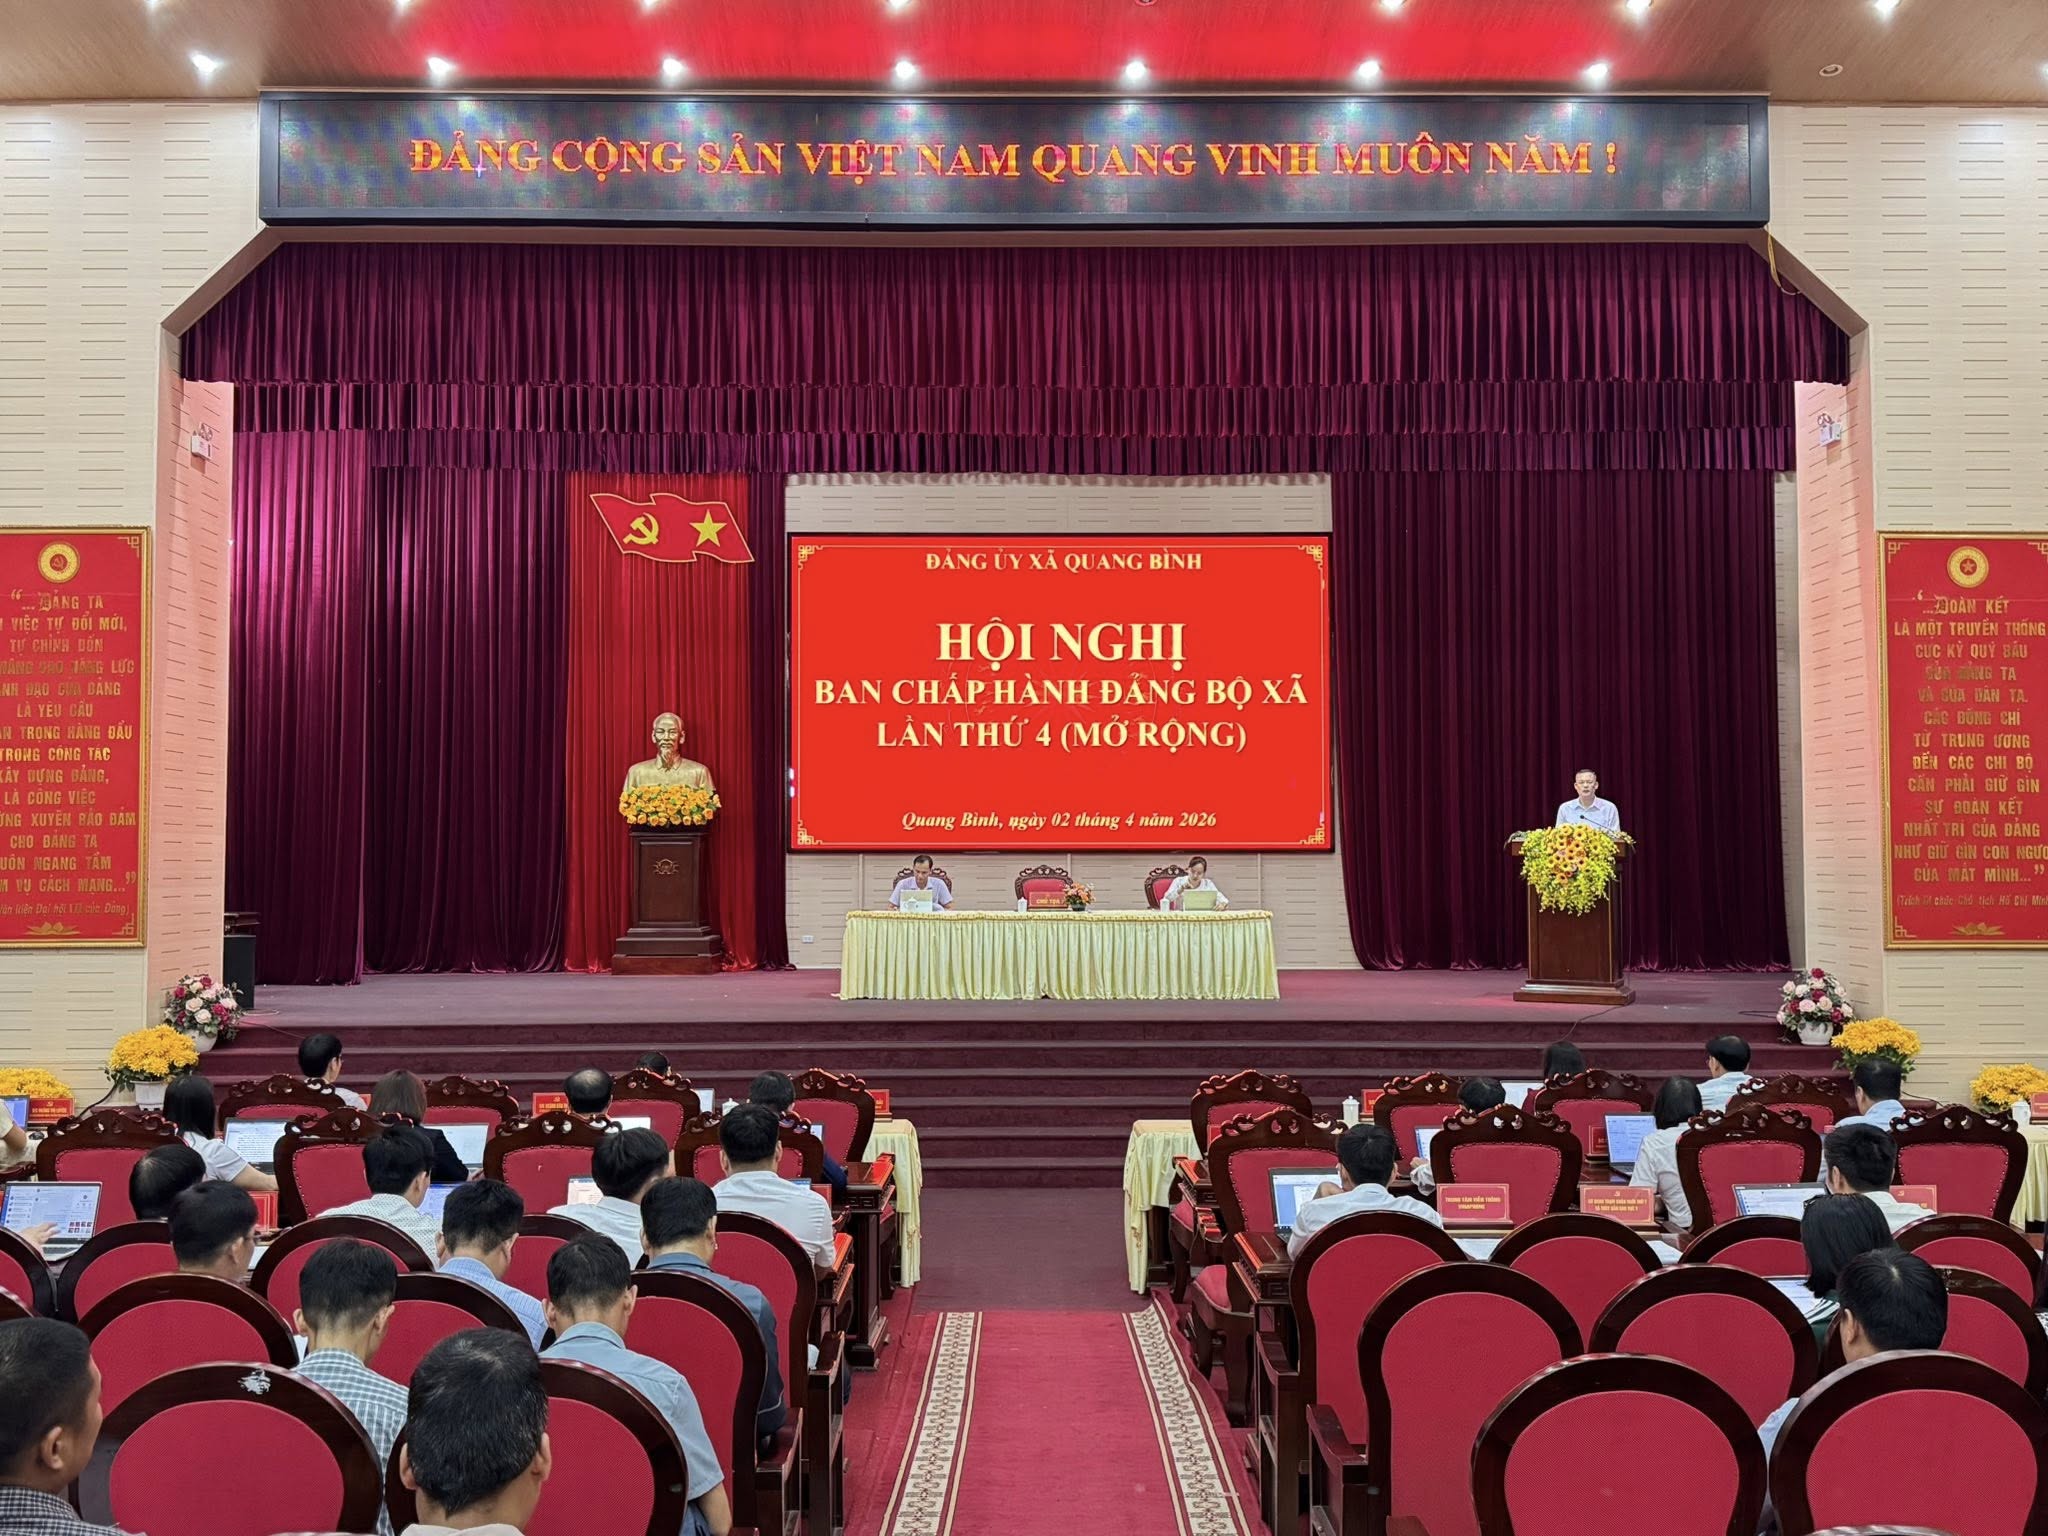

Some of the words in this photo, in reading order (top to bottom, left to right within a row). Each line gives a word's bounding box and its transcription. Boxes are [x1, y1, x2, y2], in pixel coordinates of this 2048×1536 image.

[408, 131, 539, 172] ĐẢNG
[552, 137, 686, 183] CỘNG
[697, 133, 782, 175] SẢN
[798, 139, 902, 185] VIỆT
[914, 144, 1021, 177] NAM
[1032, 144, 1197, 183] QUANG
[1206, 143, 1321, 176] VINH
[1333, 132, 1473, 175] MUÔN
[1486, 135, 1592, 175] NĂM
[926, 548, 987, 570] ĐẢNG
[994, 548, 1023, 570] ỦY
[1029, 549, 1059, 570] XÃ
[1064, 553, 1143, 573] QUANG
[1149, 547, 1203, 570] BÌNH
[936, 616, 1035, 671] HỘI
[1050, 622, 1186, 671] NGHỊ
[815, 679, 882, 705] BAN
[892, 673, 986, 704] CHẤP
[993, 673, 1090, 704] HÀNH
[1099, 672, 1196, 705] ĐẢNG
[1206, 676, 1252, 711] BỘ
[1262, 673, 1308, 704] XÃ
[877, 715, 945, 747] LẦN
[954, 715, 1029, 747] THỨ
[1035, 722, 1051, 747] 4
[1061, 714, 1130, 753] (MỞ
[1137, 717, 1247, 753] RỘNG)
[902, 812, 955, 830] Quang
[960, 812, 1003, 829] Bình,
[1008, 814, 1046, 830] ngày
[1051, 812, 1071, 827] 02
[1075, 812, 1120, 830] tháng
[1125, 812, 1134, 827] 4
[1139, 813, 1174, 827] năm
[1179, 812, 1217, 827] 2026
